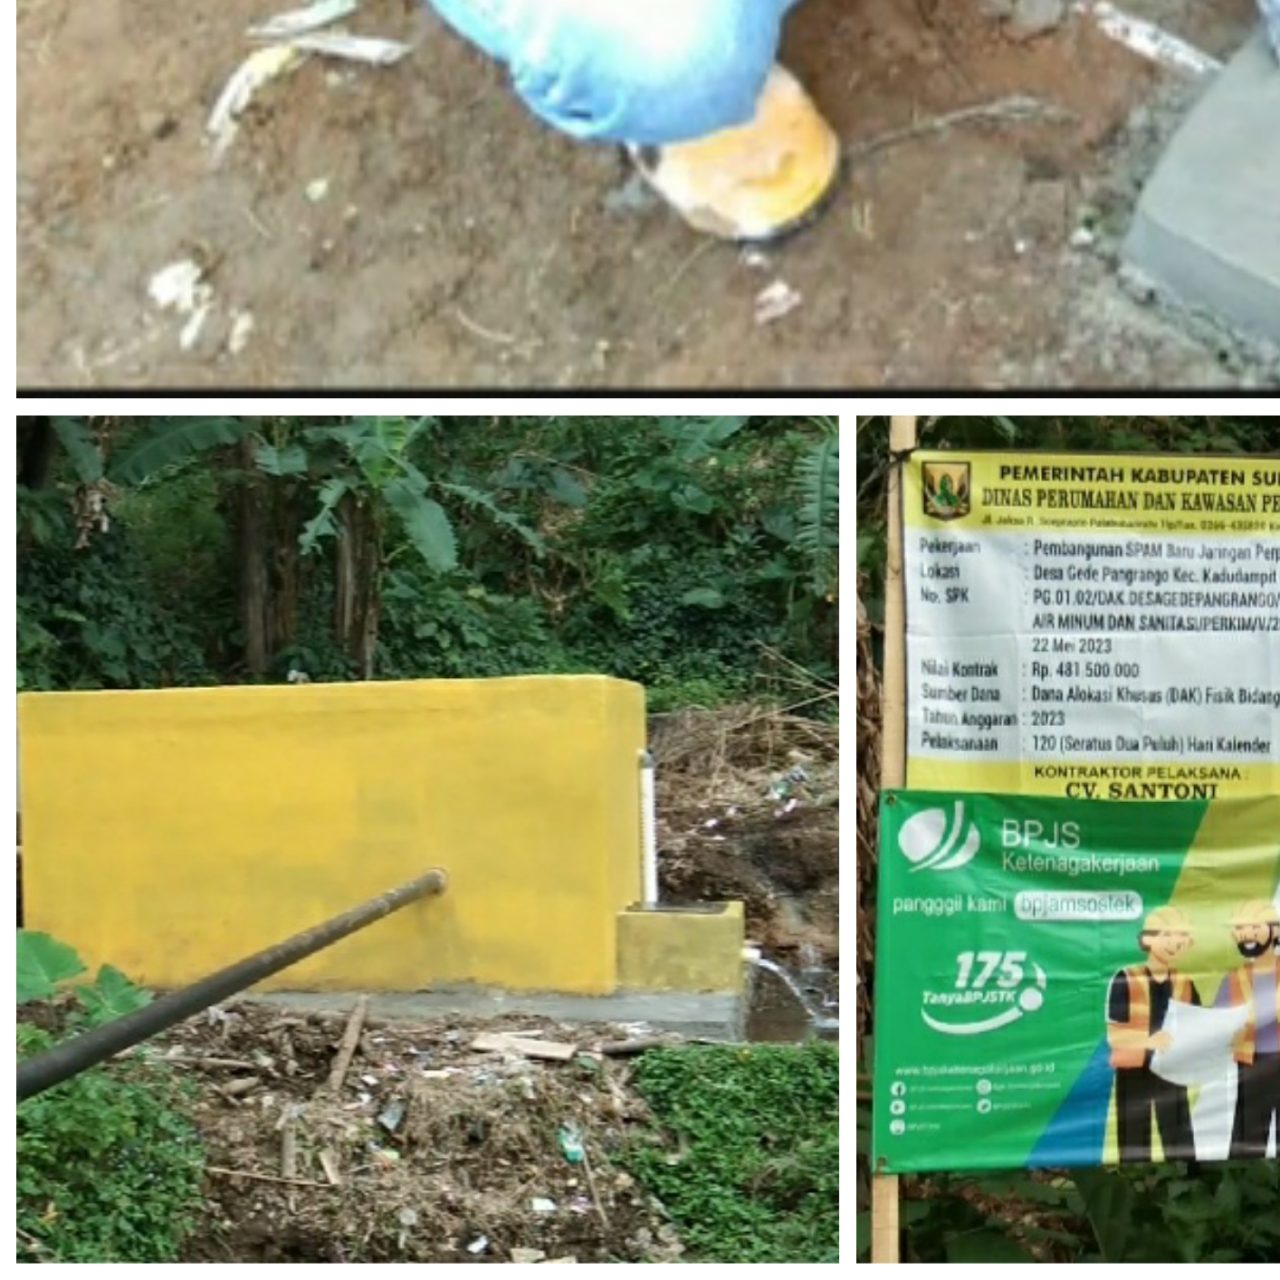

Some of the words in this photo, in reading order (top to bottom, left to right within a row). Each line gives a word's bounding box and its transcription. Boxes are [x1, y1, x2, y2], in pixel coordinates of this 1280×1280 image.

[1000, 465, 1124, 482] PEMERINTAH
[1132, 468, 1245, 485] KABUPATEN
[982, 487, 1032, 507] DINAS
[1036, 489, 1138, 509] PERUMAHAN
[1143, 492, 1176, 510] DAN
[1181, 493, 1257, 512] KAWASAN
[919, 537, 981, 556] Pekerjaan
[1034, 539, 1123, 560] Pembangunan
[1125, 543, 1162, 558] SPAM
[1166, 544, 1195, 559] Baru
[1200, 544, 1251, 563] Jaringan
[920, 562, 960, 580] Lokasi
[1034, 565, 1063, 580] Desa
[1068, 565, 1099, 582] Gede
[1102, 566, 1169, 586] Pangrango
[1173, 568, 1199, 583] Kec.
[1203, 568, 1276, 587] Kadudampit
[921, 587, 941, 603] No.
[945, 587, 969, 603] SPK
[1033, 614, 1055, 629] AIR
[1058, 614, 1104, 630] MINUM
[1108, 614, 1135, 630] DAN
[1032, 638, 1049, 652] 22
[1052, 638, 1075, 653] Mei
[1079, 638, 1112, 654] 2023
[921, 659, 949, 676] Nilai
[952, 661, 998, 677] Kontrak
[1032, 661, 1052, 681] Rp.
[921, 683, 967, 701] Sumber
[971, 686, 1000, 701] Dana
[1032, 685, 1063, 701] Dana
[1067, 686, 1112, 702] Alokasi
[1117, 687, 1162, 703] Khusus
[1166, 687, 1202, 705] (DAK)
[1206, 687, 1235, 704] Fisik
[1239, 688, 1280, 708] Bidang
[923, 707, 958, 724] Tahun
[961, 711, 1018, 730] Anggaran
[1032, 710, 1065, 726] 2023
[921, 731, 998, 751] Pelaksanaan
[1033, 735, 1056, 750] 120
[1060, 735, 1112, 754] (Seratus
[1116, 736, 1139, 751] Dua
[1143, 735, 1184, 754] Puluh)
[1187, 736, 1213, 752] Hari
[1216, 736, 1271, 753] Kalender
[1034, 766, 1142, 779] KONTRAKTOR
[1147, 767, 1241, 781] PELAKSANA
[1066, 782, 1099, 799] CV.
[1108, 782, 1218, 800] SANTONI
[1003, 819, 1081, 849] BPJS
[1003, 852, 1160, 876] Ketenagakerjaan
[968, 895, 1007, 912] kami
[1021, 895, 1136, 917] bpjamsostek
[954, 950, 1027, 988] 175
[922, 990, 1017, 1006] TanyaBPJSTK
